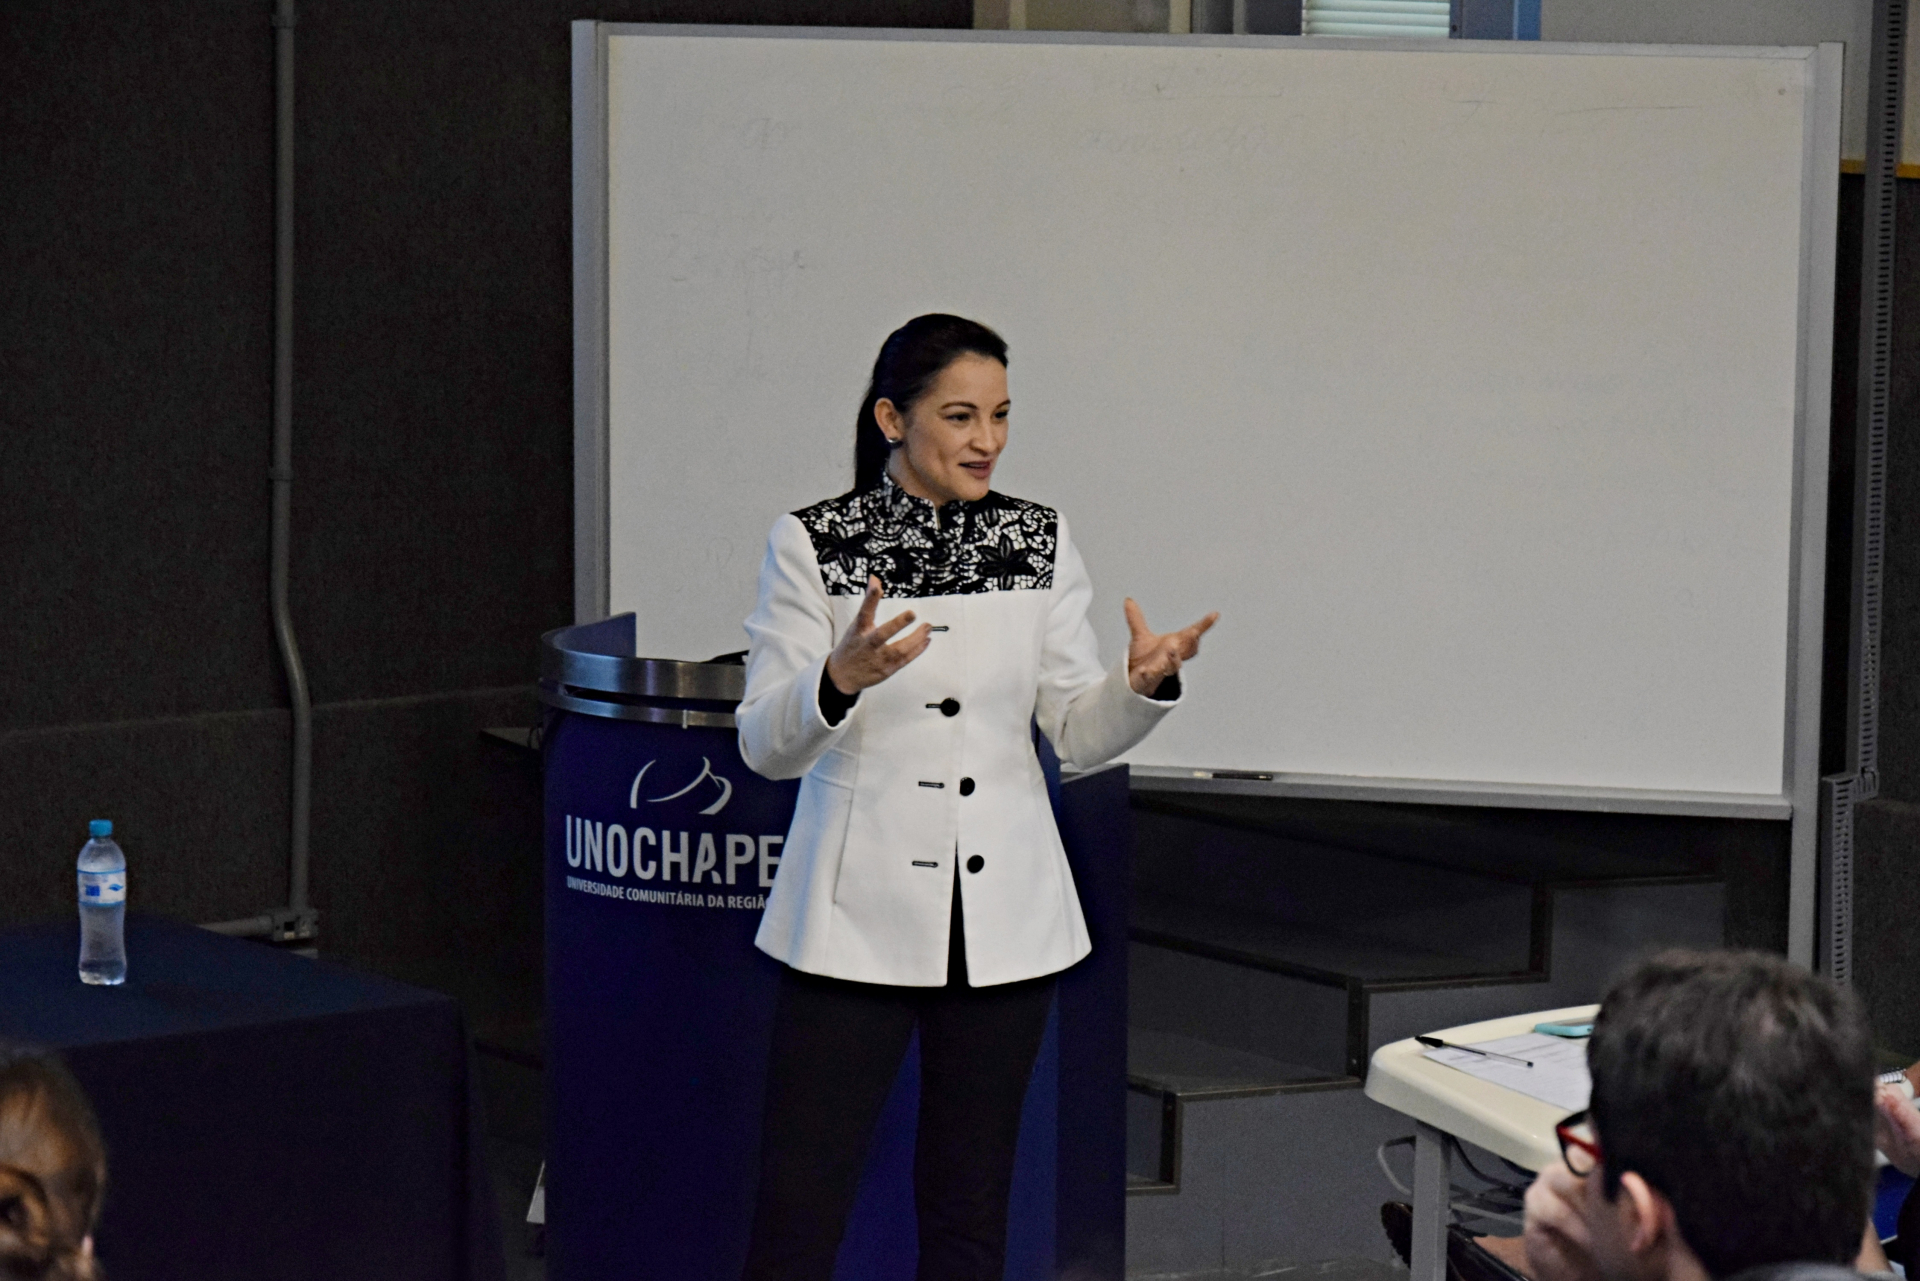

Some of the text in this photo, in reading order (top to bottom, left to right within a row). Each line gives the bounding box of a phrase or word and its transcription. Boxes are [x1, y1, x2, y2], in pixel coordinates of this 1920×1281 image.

[566, 875, 767, 909] UNIVERSIDADE COMUNITÁRIA DA REGIÃ
